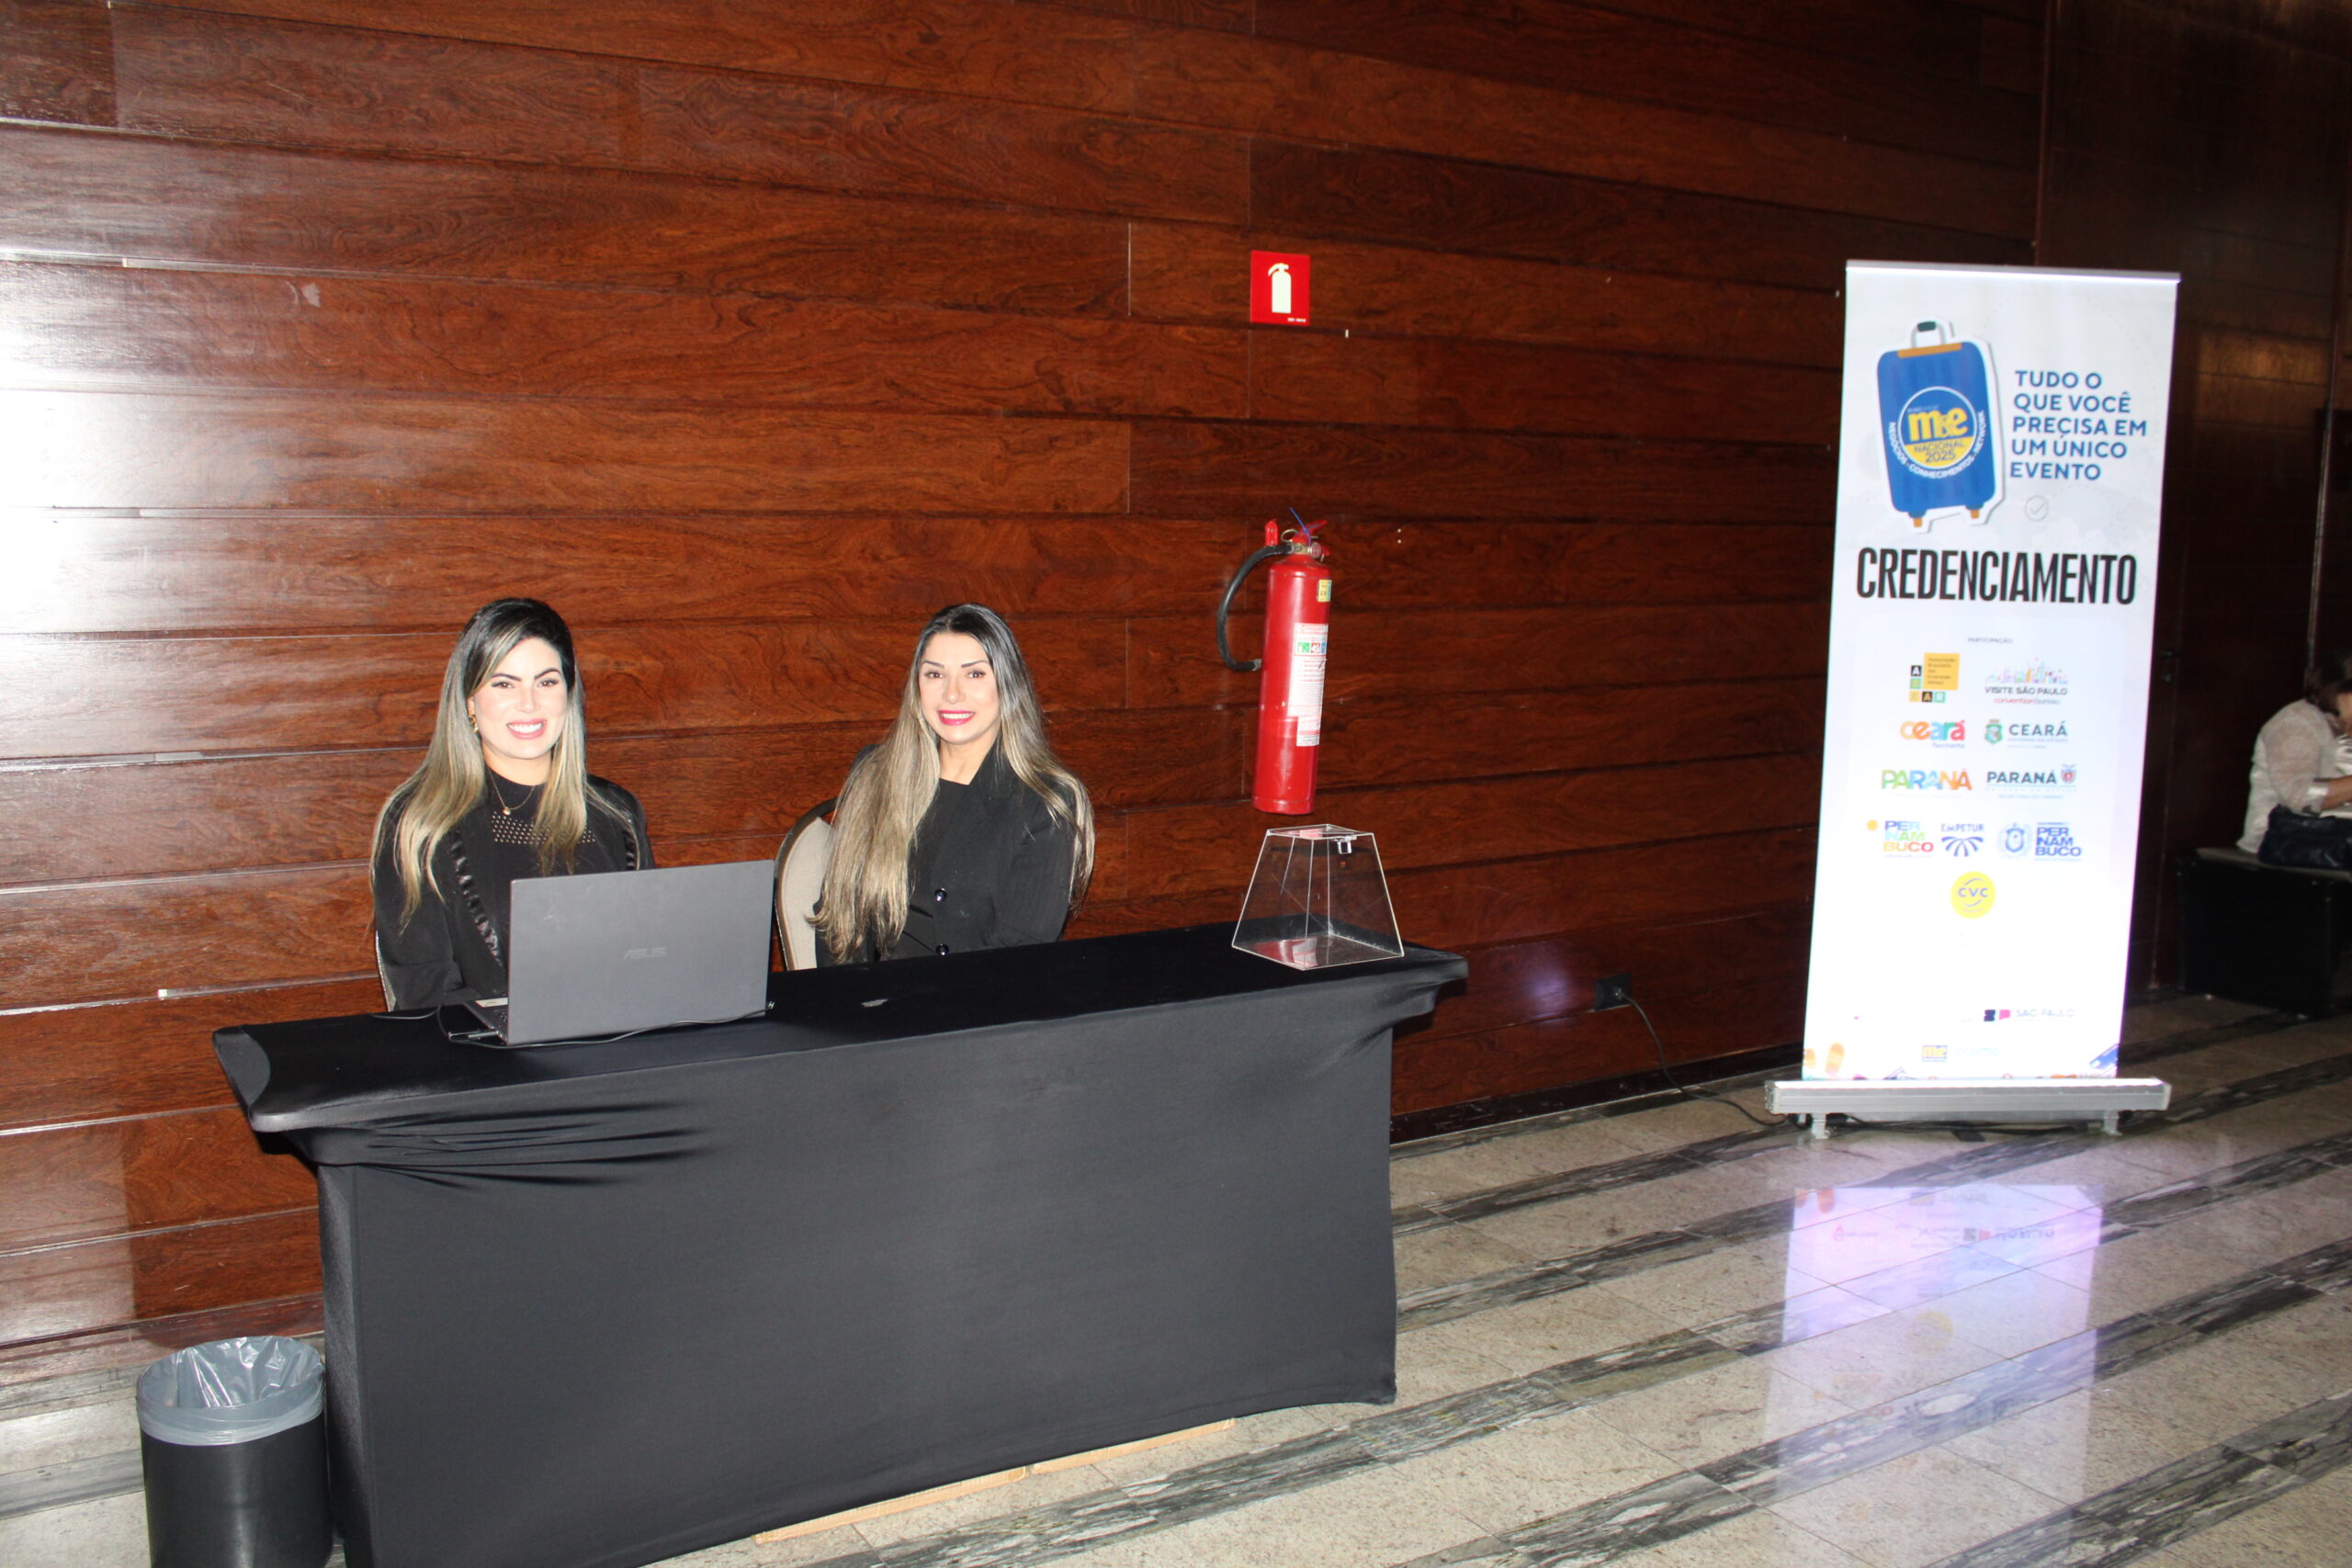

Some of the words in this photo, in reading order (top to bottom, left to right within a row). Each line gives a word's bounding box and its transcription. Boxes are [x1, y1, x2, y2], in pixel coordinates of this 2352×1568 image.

[2015, 370, 2078, 389] TUDO
[2085, 372, 2103, 389] O
[2014, 393, 2062, 413] QUE
[2068, 391, 2132, 413] VOCÊ
[2013, 416, 2109, 435] PRECISA
[2115, 420, 2147, 436] EM
[1914, 440, 1964, 453] NACIONAL
[2012, 439, 2046, 457] UM
[2052, 435, 2127, 458] ÚNICO
[1926, 447, 1956, 463] 2025
[2010, 462, 2101, 481] EVENTO
[1856, 547, 2137, 605] CREDENCIAMENTO
[1984, 686, 2014, 694] VISITE
[2016, 685, 2036, 695] SÃO
[2037, 686, 2068, 695] PAULO
[1899, 719, 1966, 741] ceará
[2008, 720, 2067, 737] CEARÁ
[1881, 769, 1973, 790] PARANÁ
[1986, 770, 2057, 784] PARANÁ
[1884, 820, 1920, 831] PER
[2037, 827, 2069, 837] PER
[1884, 831, 1926, 841] NAM
[2036, 837, 2074, 846] NAM
[1883, 841, 1934, 852] BUCO
[2035, 846, 2082, 856] BUCO
[1958, 887, 1988, 897] CVC
[623, 946, 667, 961] ASUS
